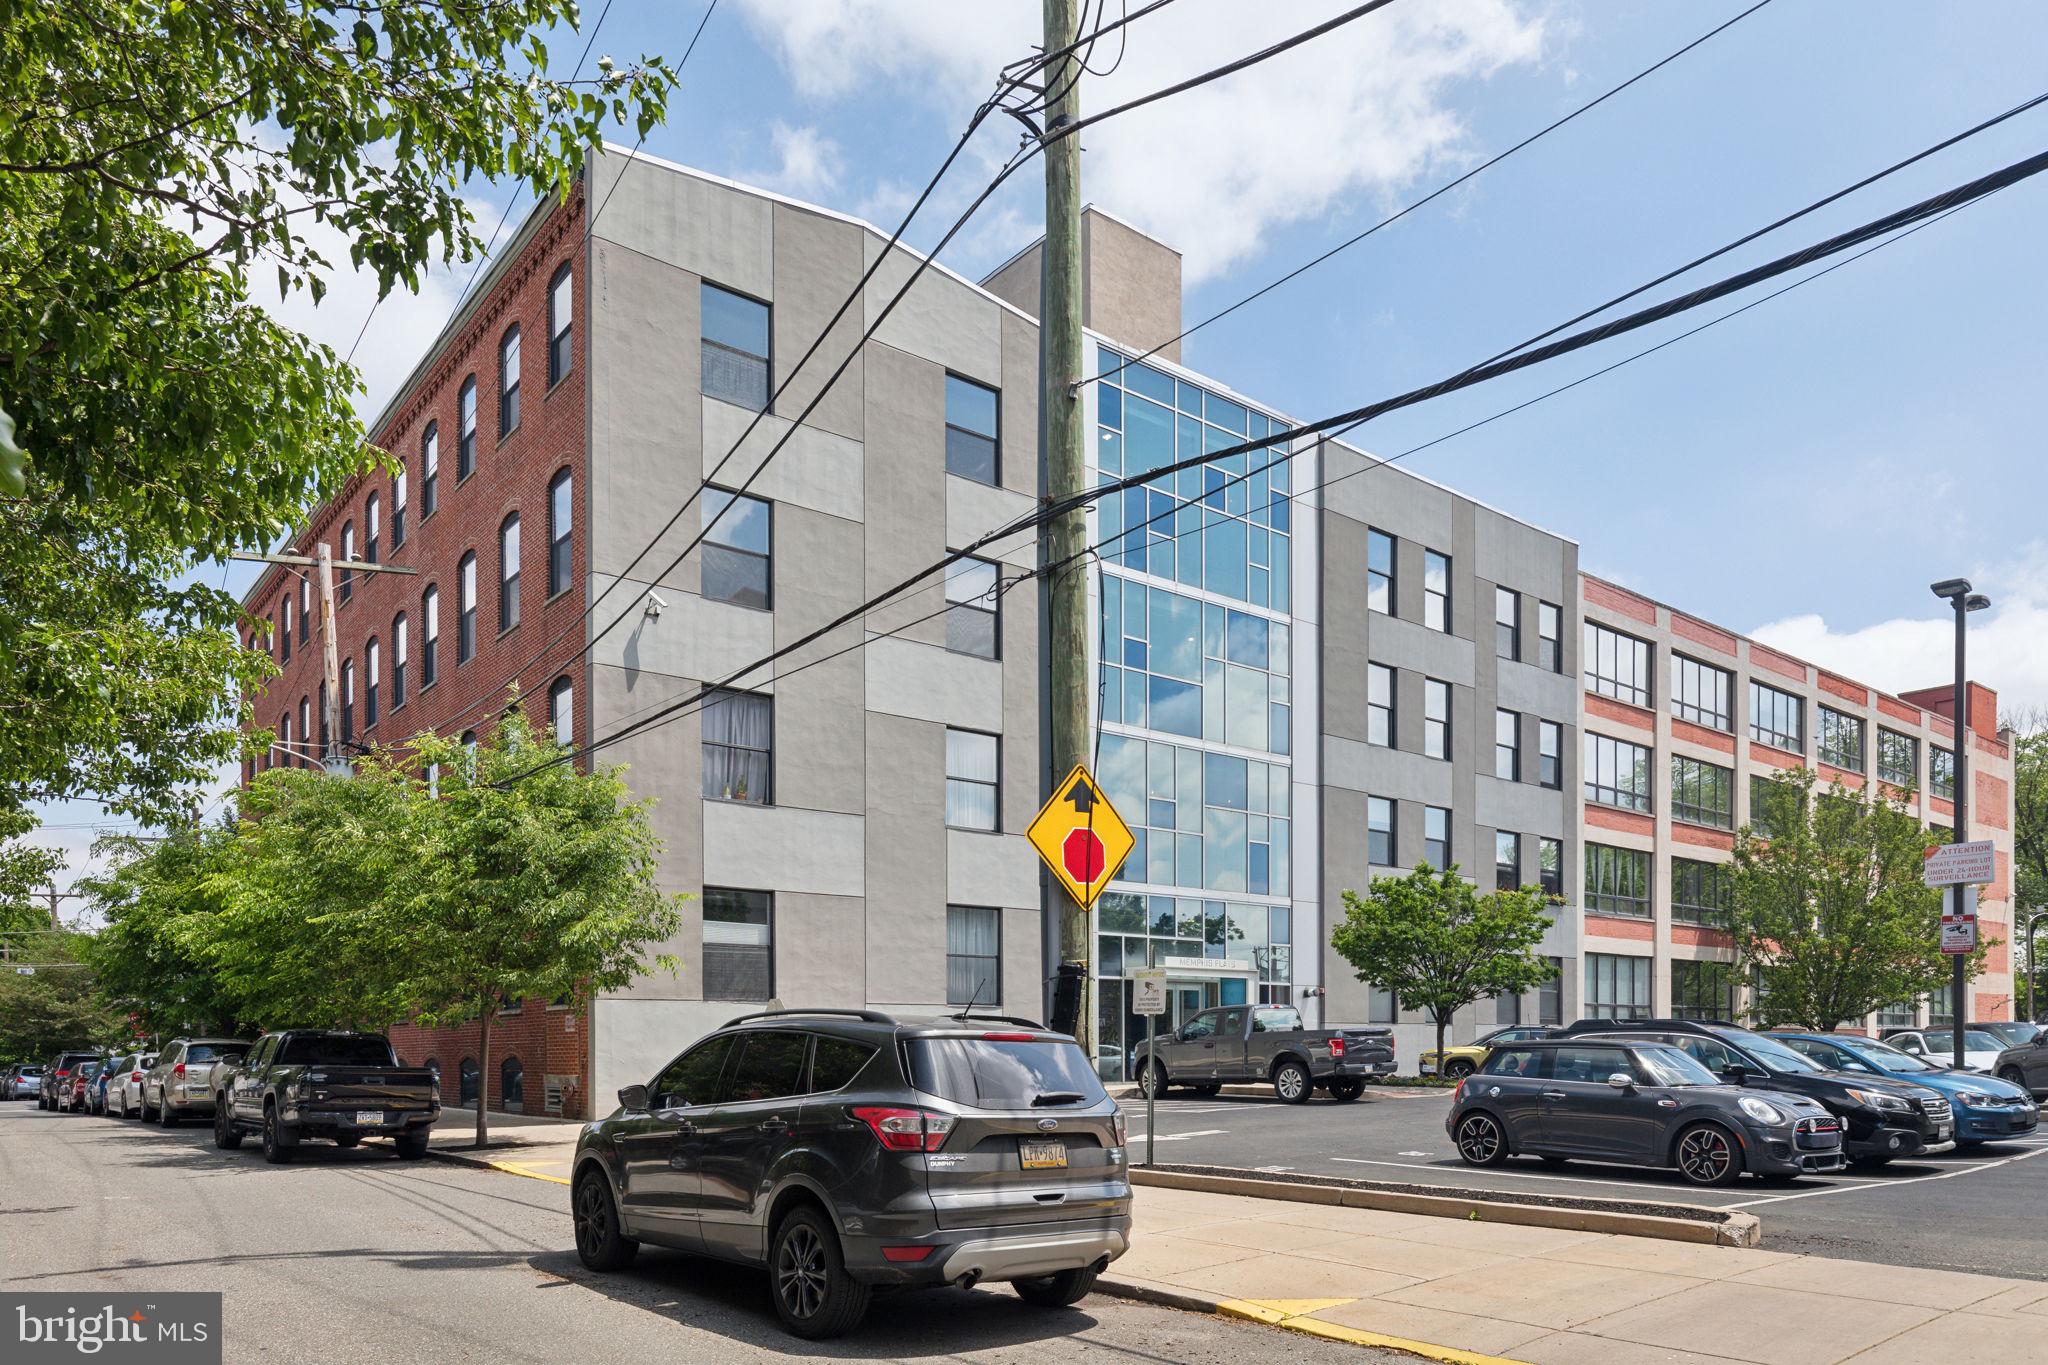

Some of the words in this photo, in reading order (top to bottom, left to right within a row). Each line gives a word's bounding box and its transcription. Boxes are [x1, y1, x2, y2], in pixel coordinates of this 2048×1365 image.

[1941, 845, 1990, 856] ATTENTION
[1926, 861, 1951, 869] PRIVATE
[1980, 856, 1991, 864] LOT
[1927, 868, 1953, 876] UNDER
[1928, 871, 1990, 881] SURVEILLANCE
[1180, 959, 1212, 968] MEMPHIS
